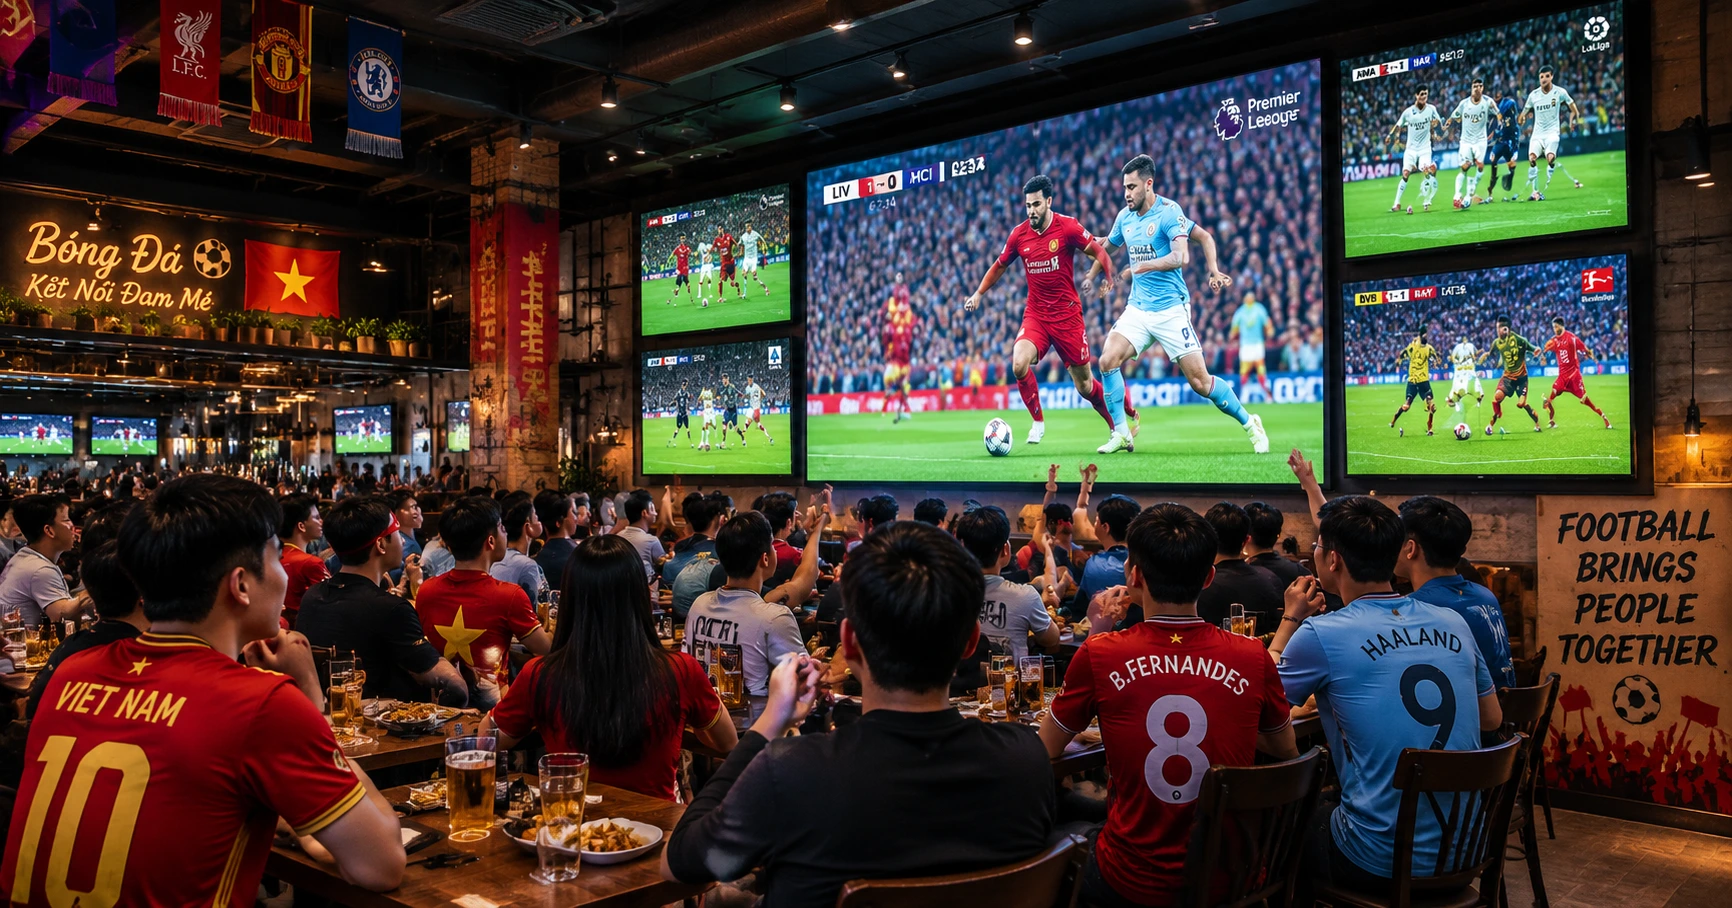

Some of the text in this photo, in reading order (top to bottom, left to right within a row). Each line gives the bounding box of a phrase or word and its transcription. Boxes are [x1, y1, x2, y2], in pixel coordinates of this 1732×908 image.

[172, 58, 207, 79] L.F.C.
[1248, 91, 1301, 113] Premier
[832, 184, 851, 199] LIV
[26, 221, 183, 279] Bóng Đá
[120, 281, 174, 308] Đam
[1558, 509, 1715, 544] FOOTBALL
[1576, 551, 1698, 583] BRINGS
[1574, 593, 1698, 624] PEOPLE
[1360, 628, 1462, 661] HAALAND
[1558, 633, 1718, 667] TOGETHER
[1109, 654, 1249, 696] B.FERNANDES
[55, 681, 187, 728] VIET NAM
[1399, 664, 1456, 750] 9
[1144, 694, 1210, 804] 8
[11, 735, 151, 908] 10
